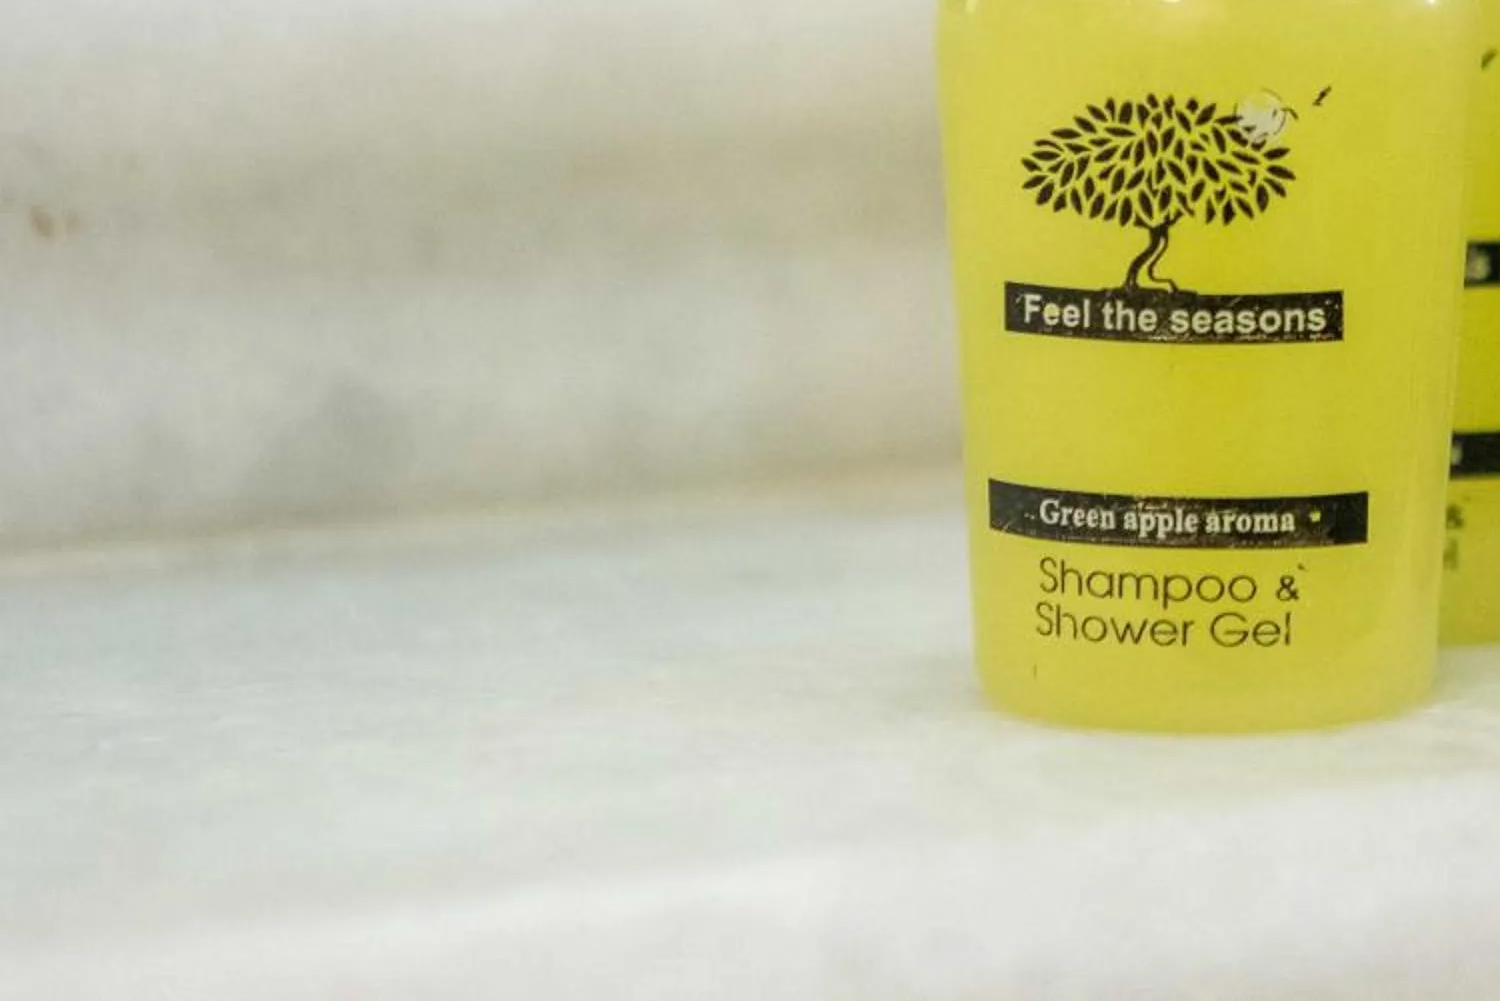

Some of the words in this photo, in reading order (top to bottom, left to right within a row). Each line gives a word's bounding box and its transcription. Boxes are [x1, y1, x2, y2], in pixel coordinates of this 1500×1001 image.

[1023, 294, 1091, 328] Feel
[1101, 302, 1158, 332] the
[1171, 306, 1327, 335] seasons
[1039, 499, 1116, 530] Green
[1124, 507, 1199, 538] apple
[1204, 511, 1295, 534] aroma
[1039, 556, 1257, 609] Shampoo
[1276, 575, 1299, 601] &
[1035, 602, 1195, 646] Shower
[1209, 611, 1293, 648] Gel
